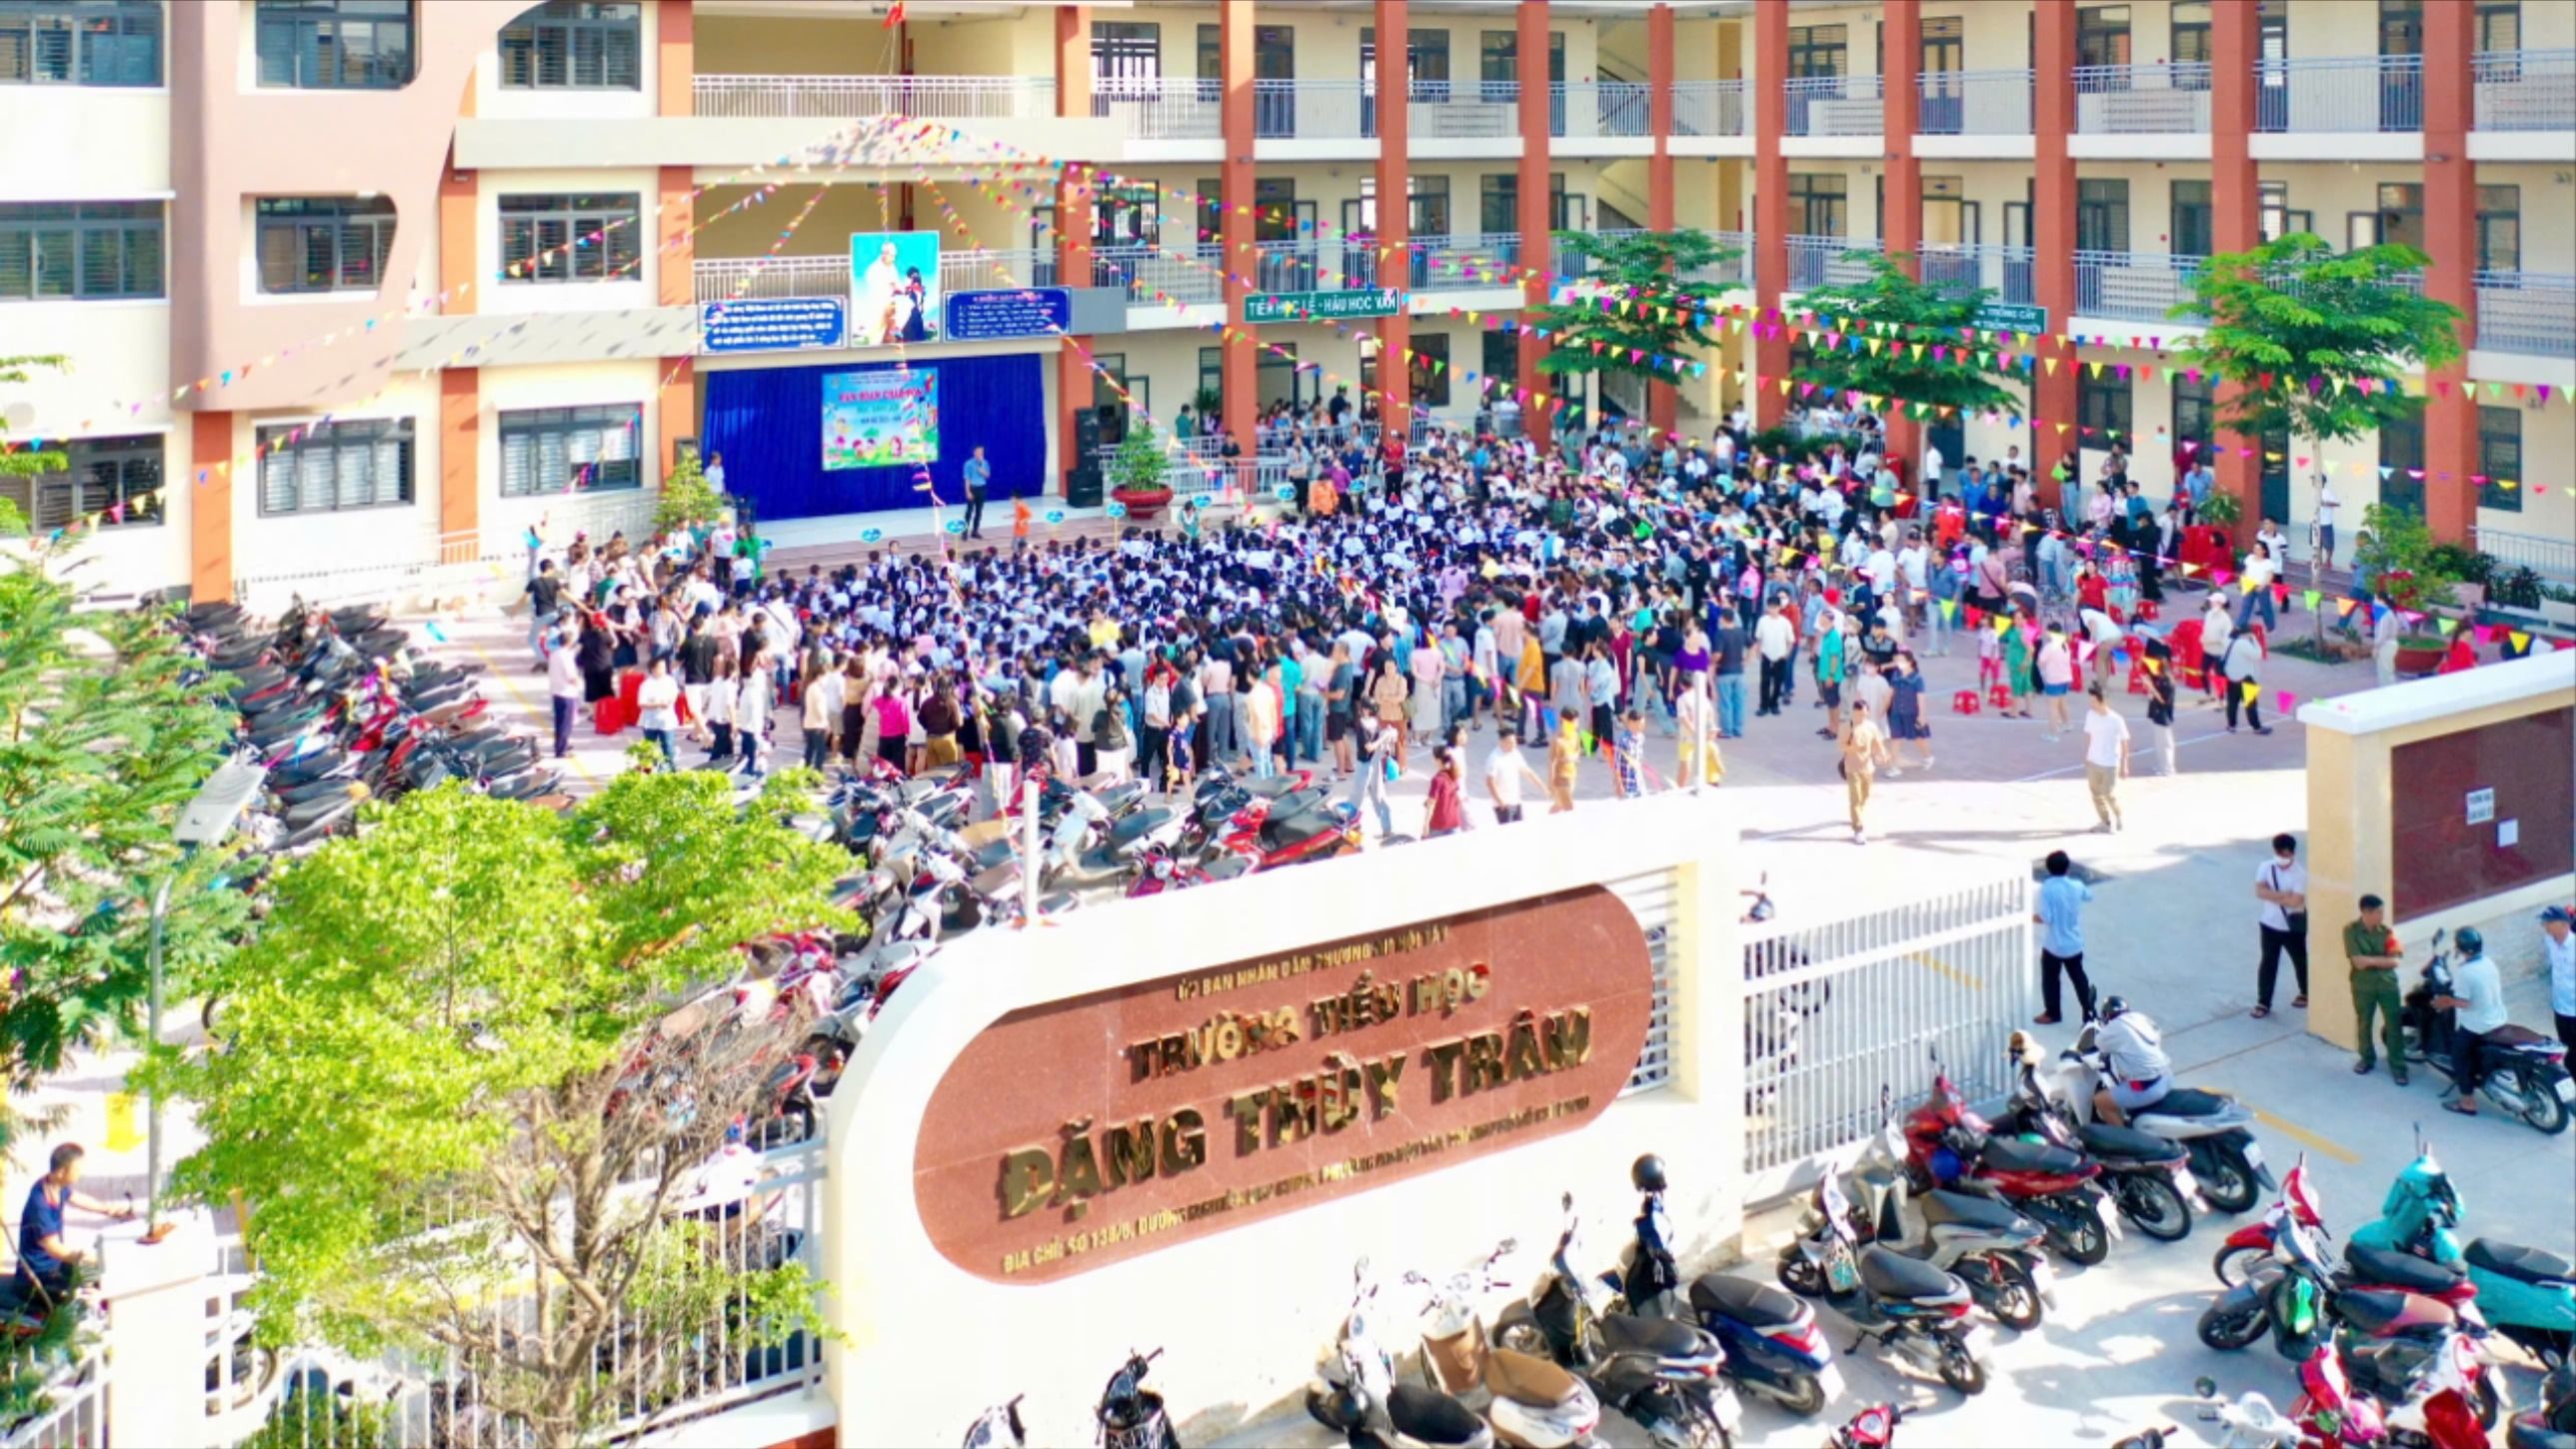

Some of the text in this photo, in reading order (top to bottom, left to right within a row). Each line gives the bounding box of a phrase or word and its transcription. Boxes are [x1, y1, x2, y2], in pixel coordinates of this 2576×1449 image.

[1277, 300, 1299, 315] HC
[1202, 973, 1234, 995] BAN
[1236, 961, 1280, 988] NHÂN
[1281, 954, 1311, 978] DÂN
[1131, 962, 1490, 1080] TRƯỜNG TIỂU HỌC
[998, 1104, 1206, 1222] ĐẶNG
[1225, 1051, 1406, 1156] THÙY
[1422, 1006, 1591, 1105] TRÂM
